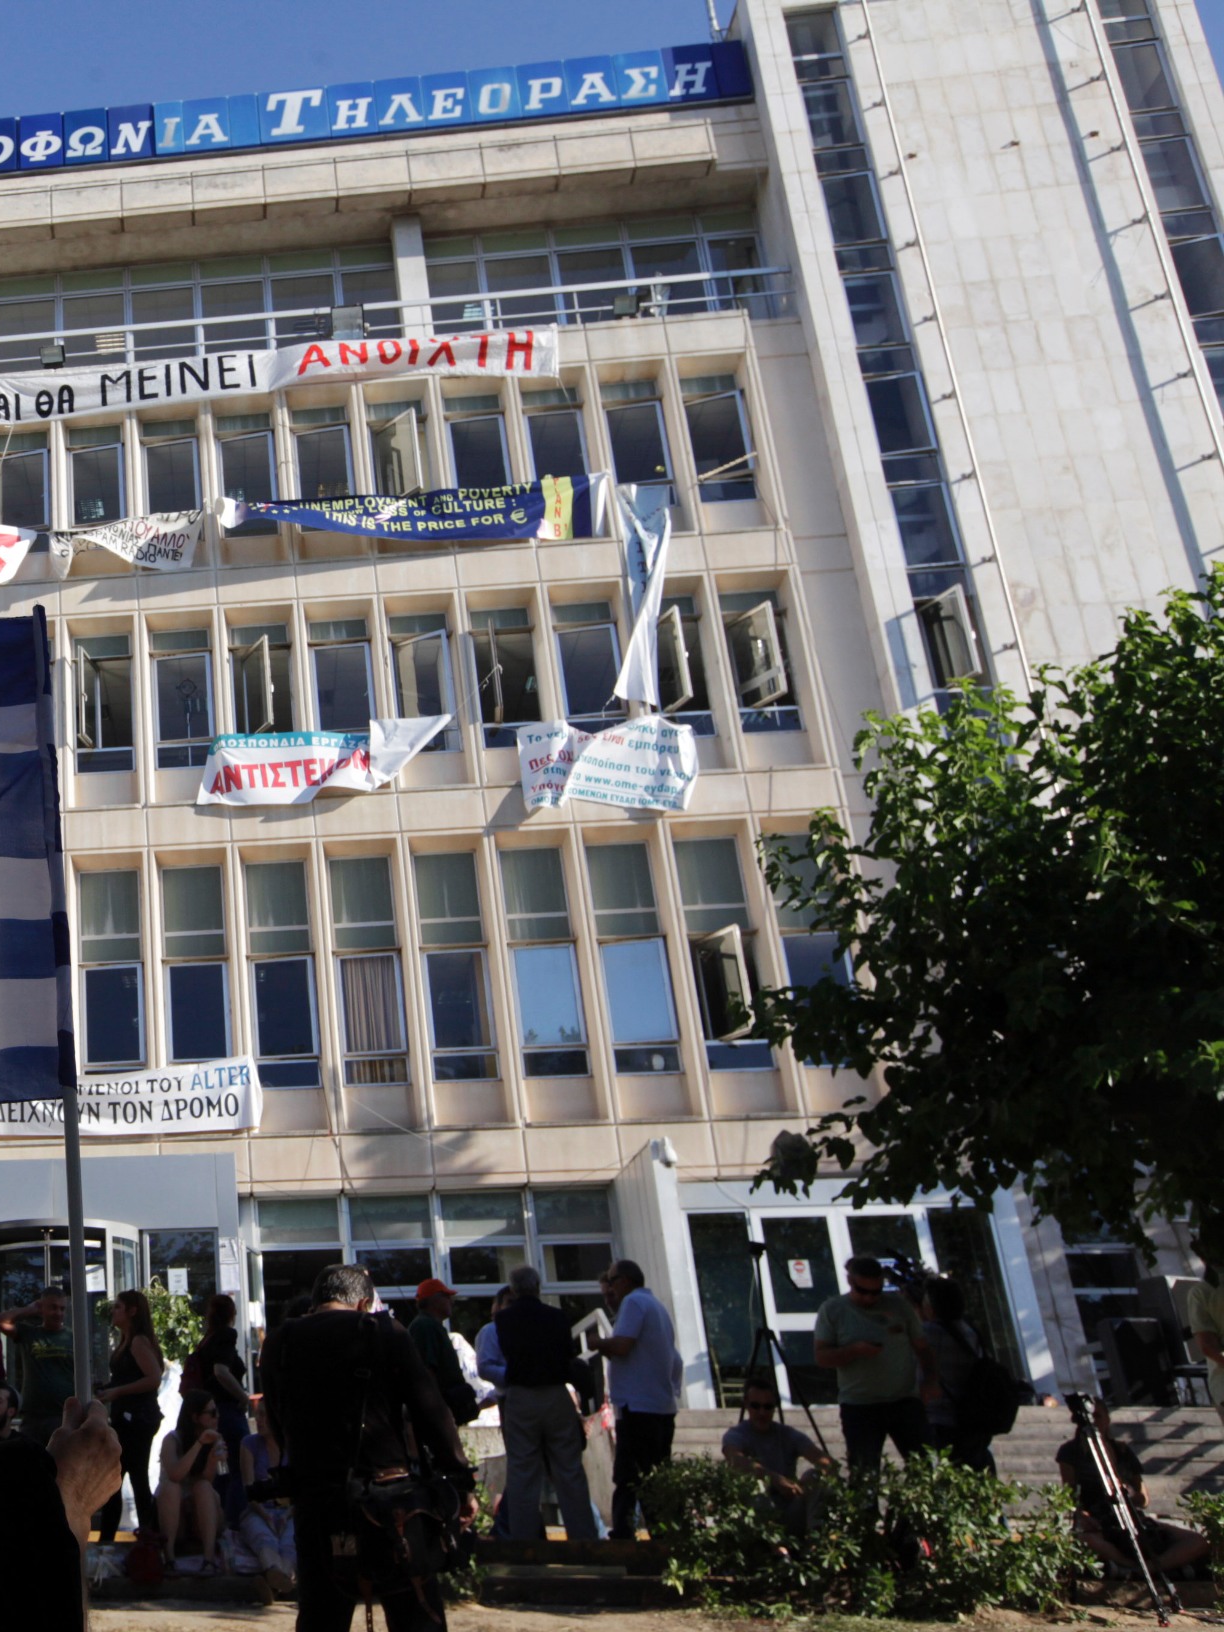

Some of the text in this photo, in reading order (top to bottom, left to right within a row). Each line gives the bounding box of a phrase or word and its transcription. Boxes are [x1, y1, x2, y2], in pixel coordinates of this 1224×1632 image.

[266, 61, 712, 136] ΤΗΛΕΟΡΑΣΗ
[34, 384, 75, 419] ΘΑ
[99, 353, 258, 407] ΜΕΙΝΕΙ
[413, 509, 427, 517] OF
[431, 497, 506, 516] CULTURE
[433, 494, 454, 504] AND
[457, 482, 533, 500] POVERTY
[325, 511, 357, 527] THIS
[362, 516, 376, 530] IS
[380, 521, 413, 532] THE
[417, 519, 466, 531] PRICE
[470, 513, 505, 526] FOR
[146, 1076, 184, 1093] ΤΟΥ
[190, 1064, 251, 1091] ALTER
[107, 1100, 153, 1124] ΤΟΝ
[160, 1092, 239, 1121] ΔΡΟΜΟ
